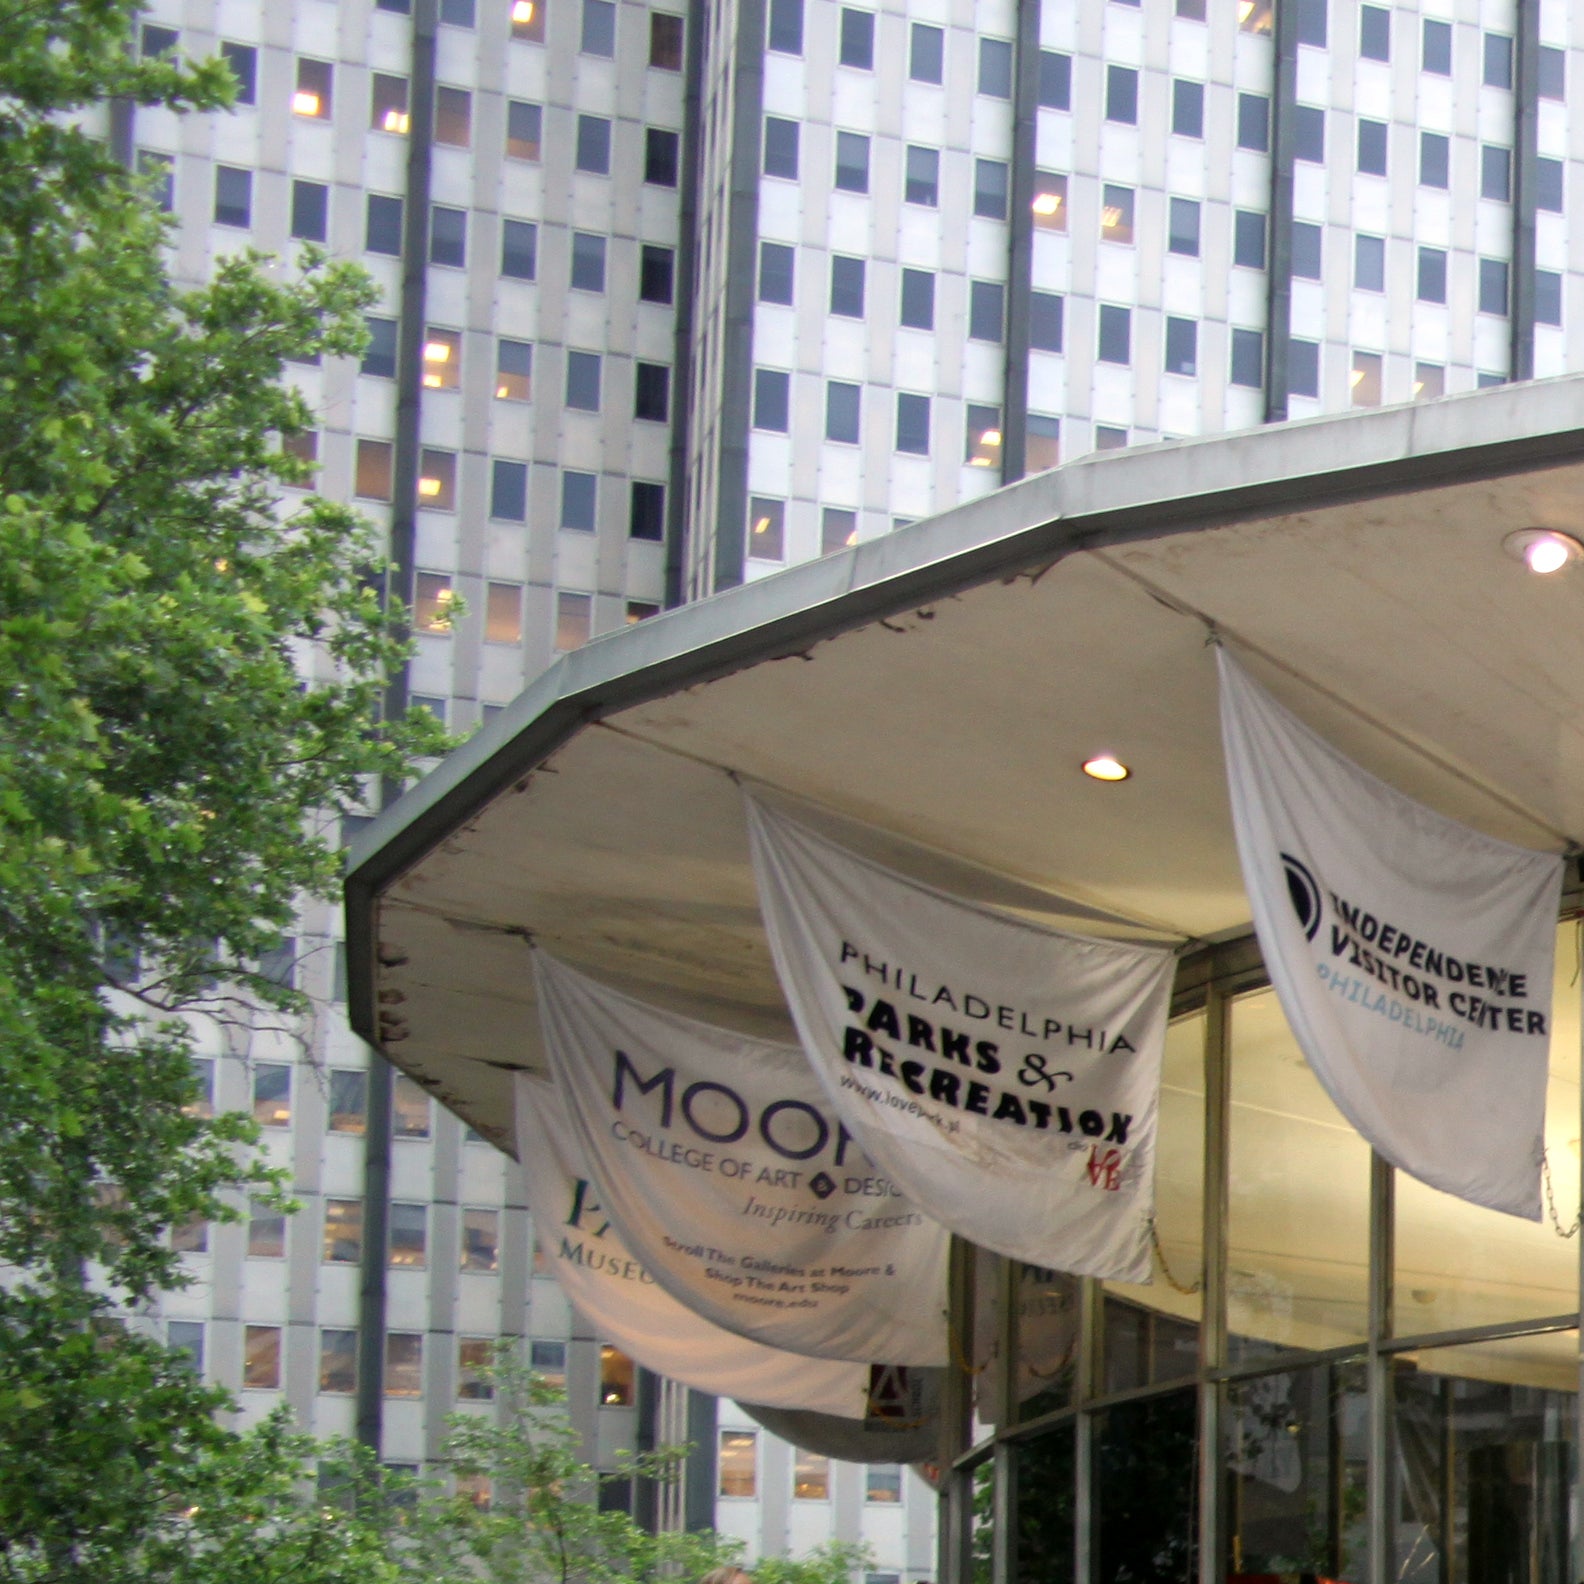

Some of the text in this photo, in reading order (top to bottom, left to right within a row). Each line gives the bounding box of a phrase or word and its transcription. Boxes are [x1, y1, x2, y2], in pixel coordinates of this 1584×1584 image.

[1328, 890, 1528, 998] INDEPENDENCE
[1331, 924, 1440, 1010] VISITOR
[840, 941, 1136, 1054] PHILADELPHIA
[841, 984, 1073, 1092] PARKS &
[1316, 962, 1466, 1051] PHILADELPHIA
[843, 1026, 1133, 1145] RECREATION
[612, 1121, 713, 1171] COLLEGE
[718, 1157, 752, 1180] OF
[756, 1168, 801, 1190] ART
[663, 1236, 896, 1278] Stroll The Galleries at Moore &
[742, 1196, 922, 1233] Inspiring Careers
[705, 1268, 849, 1295] Shop The Art Shop
[733, 1293, 819, 1308] moore.edu
